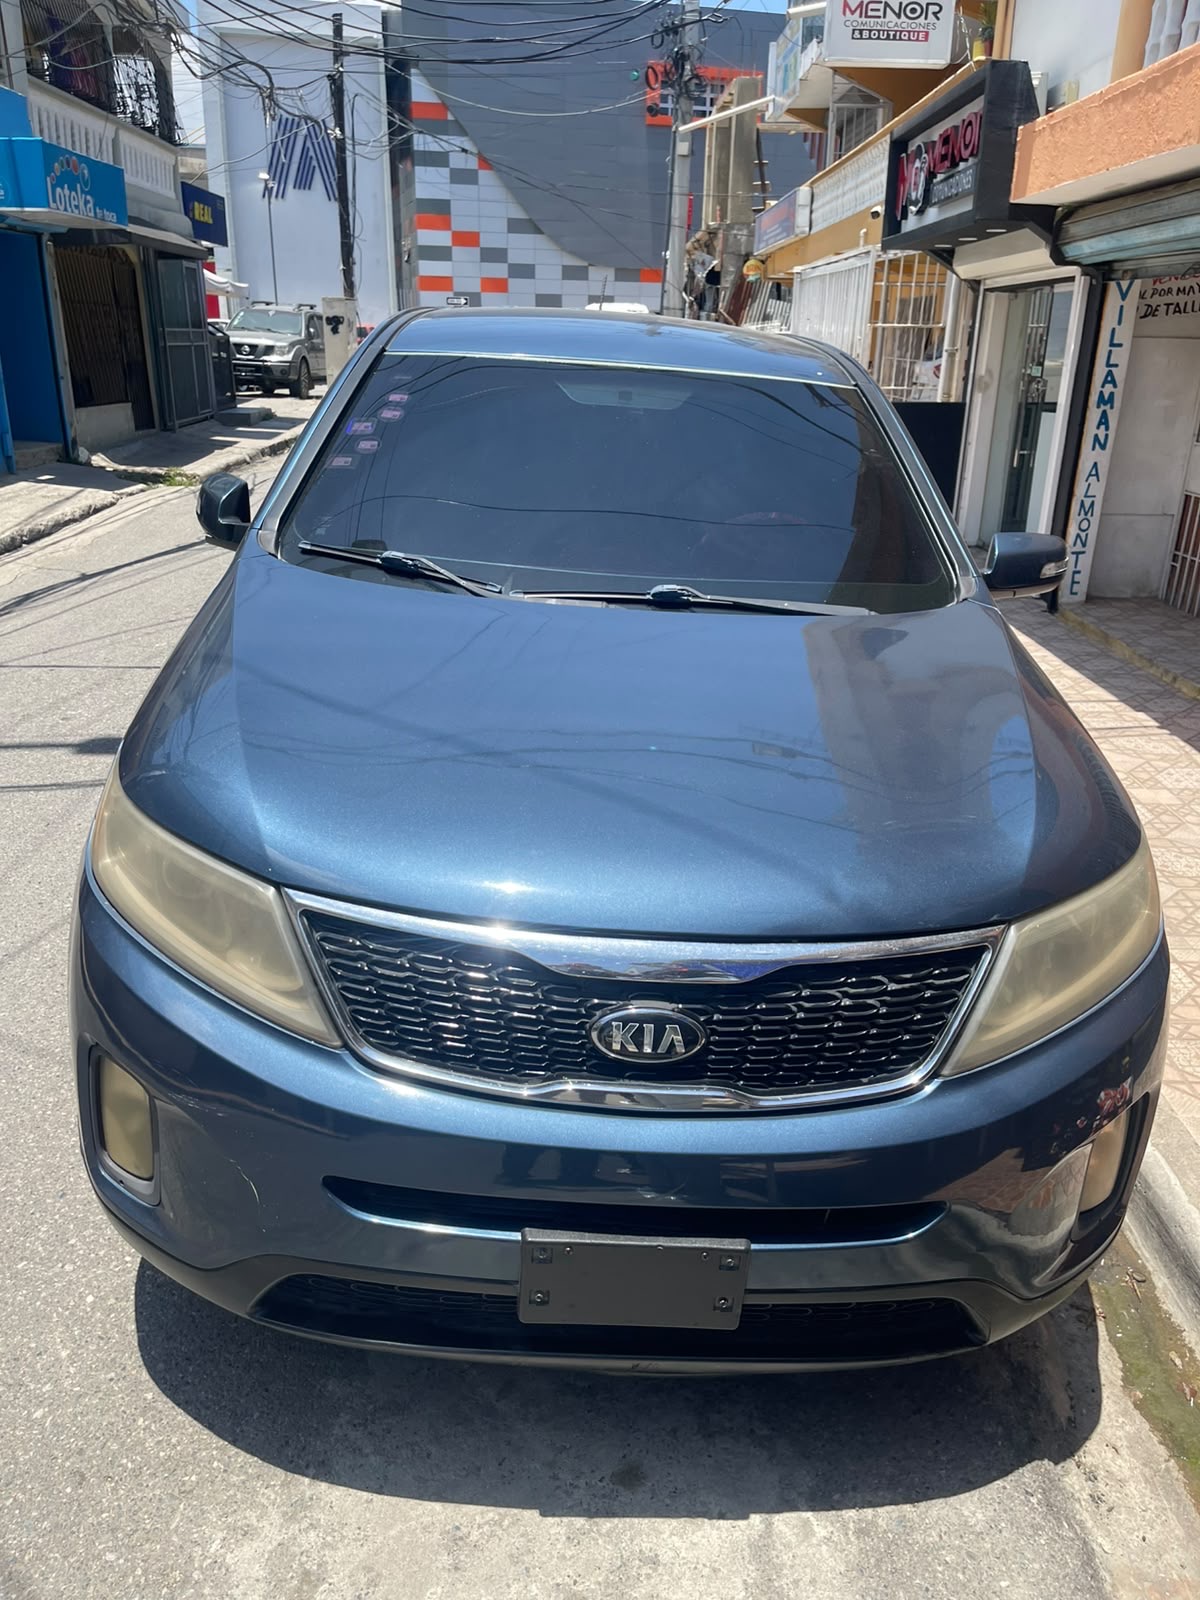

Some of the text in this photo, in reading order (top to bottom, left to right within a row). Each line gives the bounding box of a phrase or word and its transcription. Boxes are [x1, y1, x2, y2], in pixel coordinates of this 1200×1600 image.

[842, 0, 943, 21] MENOR
[844, 19, 937, 30] COMUNICACIONES
[853, 30, 926, 41] &BOUTIQUE
[47, 176, 94, 218] Loteka
[193, 201, 213, 225] REAL
[1150, 287, 1174, 299] POR
[1069, 280, 1135, 596] VILLAMAN ALMONTE
[611, 1021, 686, 1053] KIA
